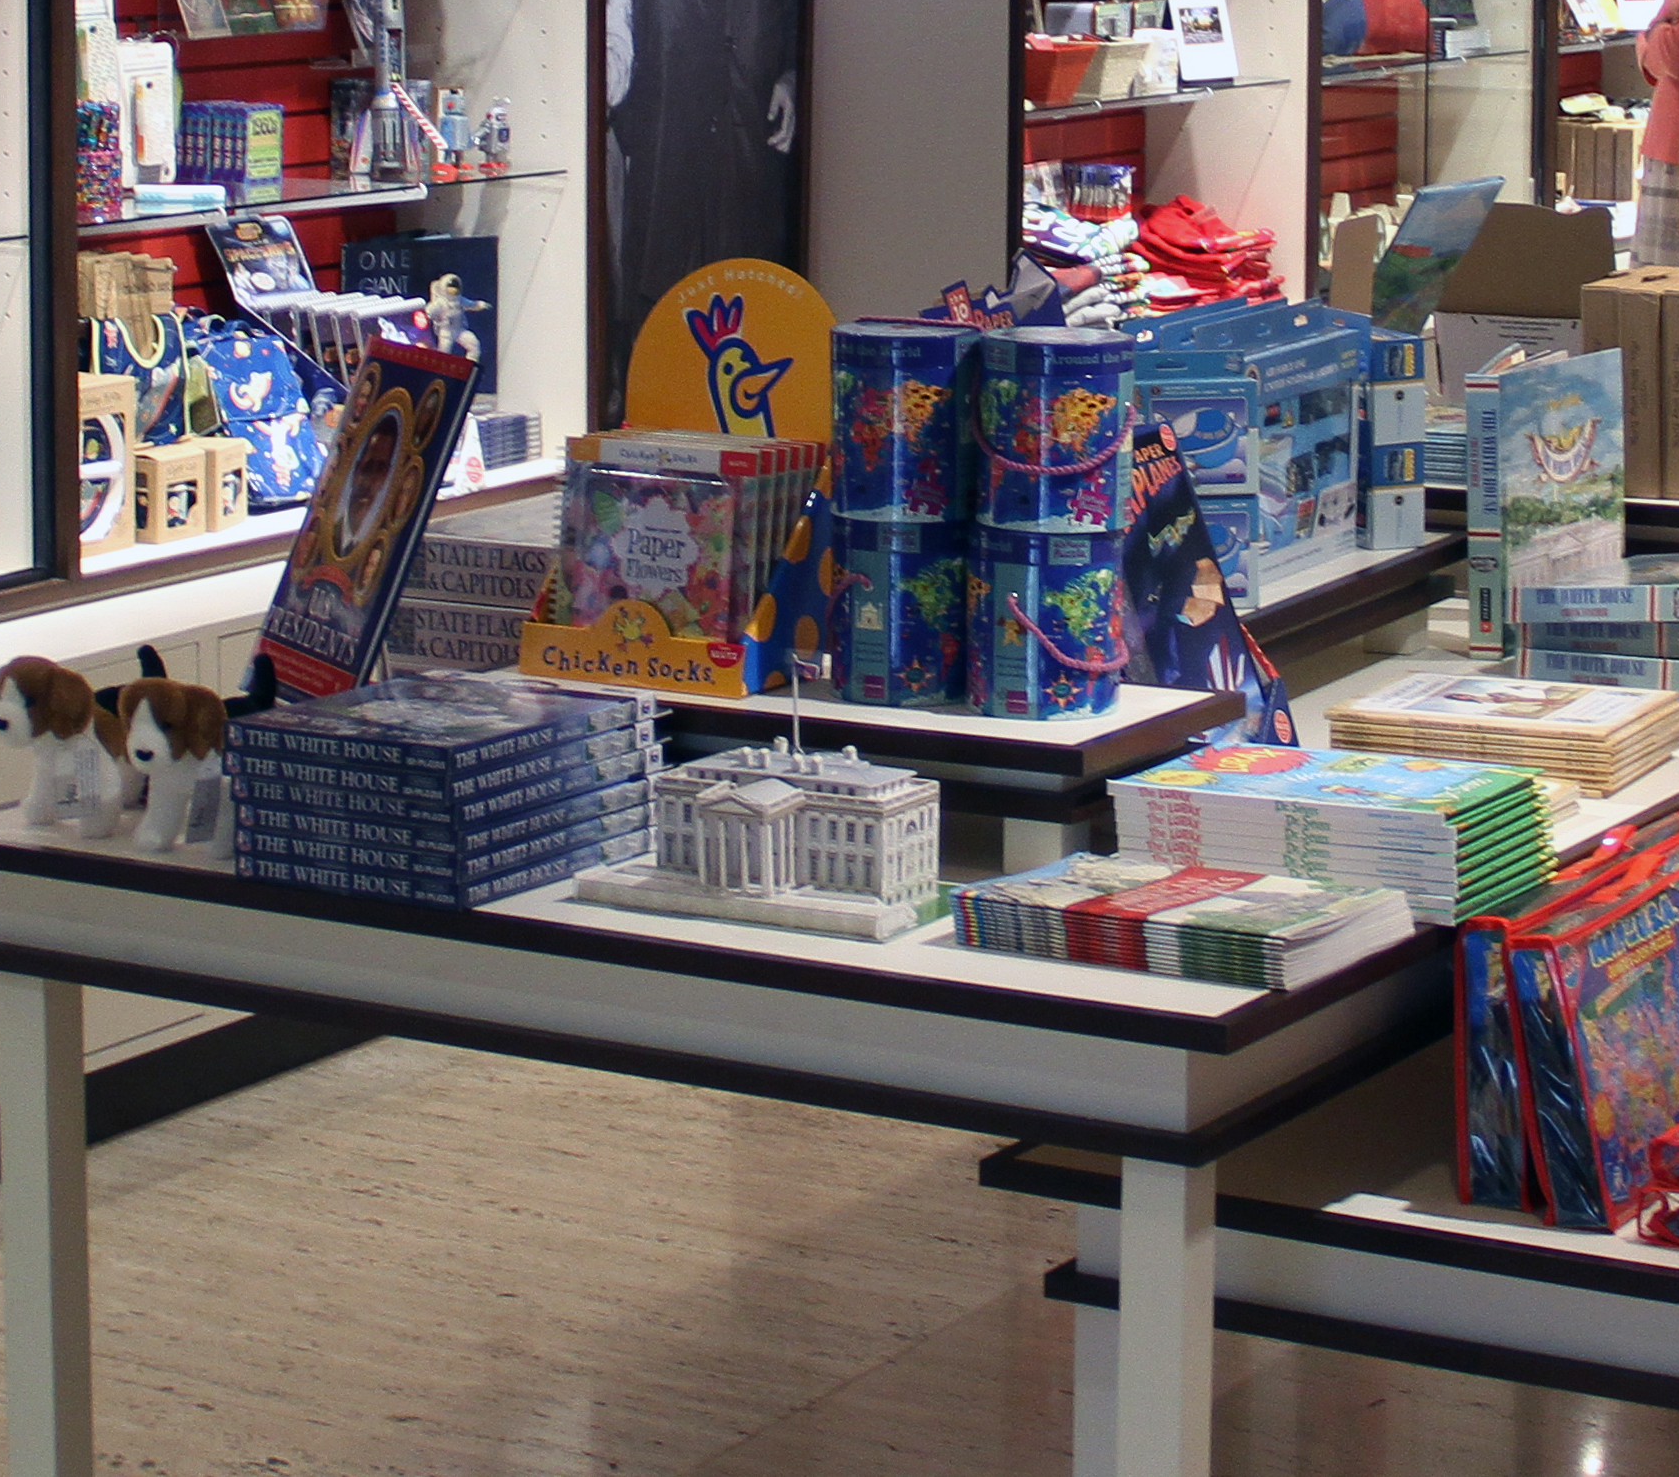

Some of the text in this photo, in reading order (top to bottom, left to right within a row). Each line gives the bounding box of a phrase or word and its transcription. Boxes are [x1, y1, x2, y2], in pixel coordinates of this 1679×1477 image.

[358, 249, 412, 270] ONE
[358, 274, 410, 295] GIANT
[952, 302, 969, 322] 10
[1481, 409, 1497, 433] THE
[1133, 443, 1166, 463] APER
[425, 538, 548, 573] STATE FLAGS
[627, 527, 685, 562] Paper
[440, 574, 537, 601] CAPITOLS
[475, 615, 523, 640] FLAG
[542, 645, 639, 678] Chicken
[246, 729, 403, 765] THE WHITE HOUSE
[243, 758, 399, 794] THE WHITE HOUSE
[251, 781, 407, 817] THE WHITE HOUSE
[256, 809, 413, 846] THE WHITE HOUSE
[254, 834, 409, 871] THE WHITE HOUSE
[256, 860, 413, 898] THE WHITE HOUSE
